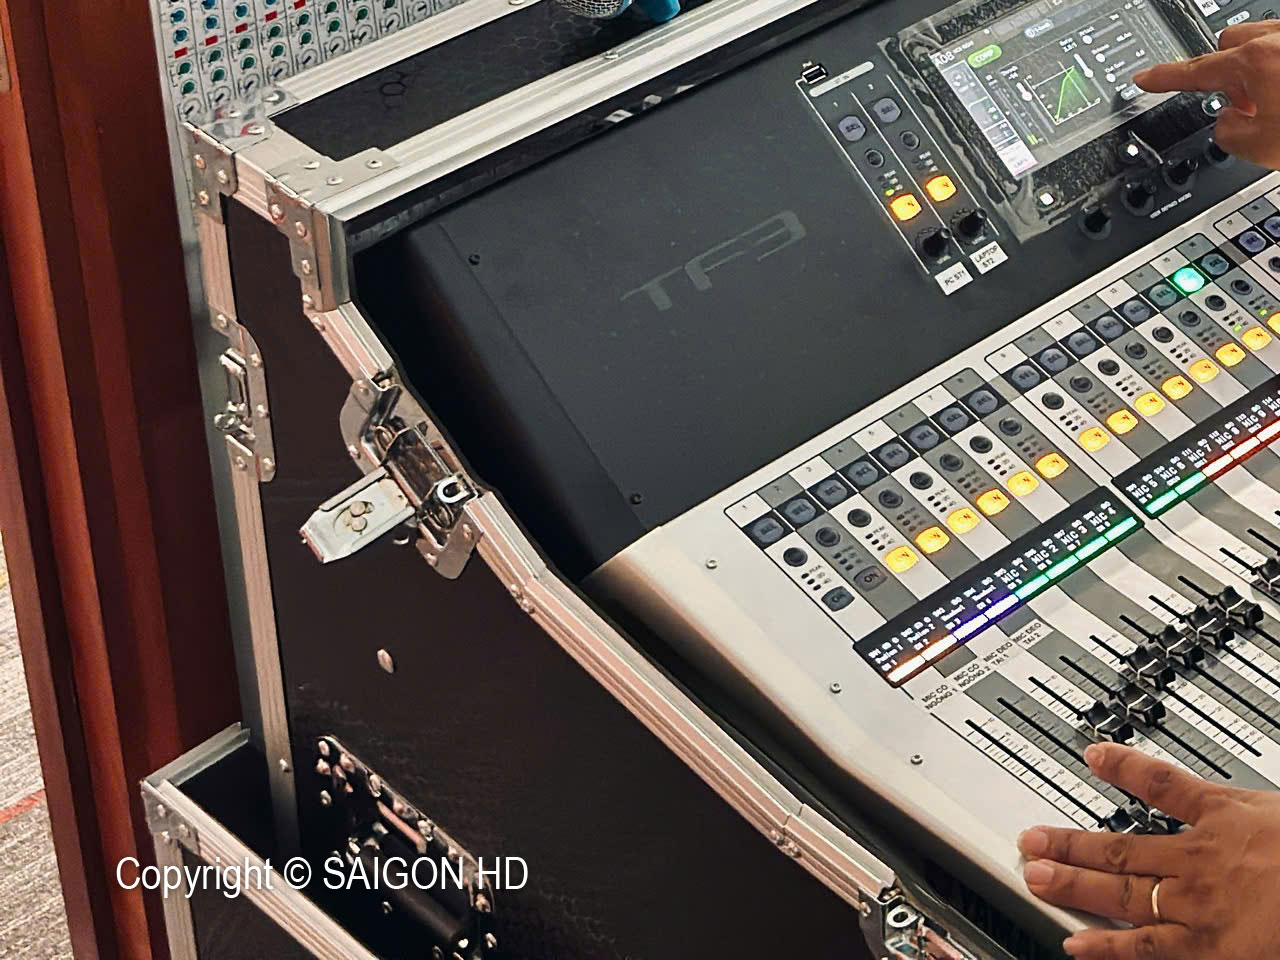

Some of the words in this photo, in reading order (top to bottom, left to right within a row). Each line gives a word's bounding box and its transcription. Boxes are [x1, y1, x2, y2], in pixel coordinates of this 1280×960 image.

[1201, 0, 1214, 9] REV
[973, 245, 1000, 262] LAPTOP
[981, 257, 995, 267] ST2
[1240, 414, 1259, 427] MIC
[1213, 431, 1233, 445] MIC
[1186, 448, 1205, 462] MIC
[1159, 466, 1178, 480] MIC
[1130, 483, 1150, 498] MIC
[1088, 511, 1109, 526] MIC
[1059, 530, 1080, 545] MIC
[1030, 549, 1050, 564] MIC
[862, 571, 879, 583] ON
[1000, 568, 1021, 583] MIC
